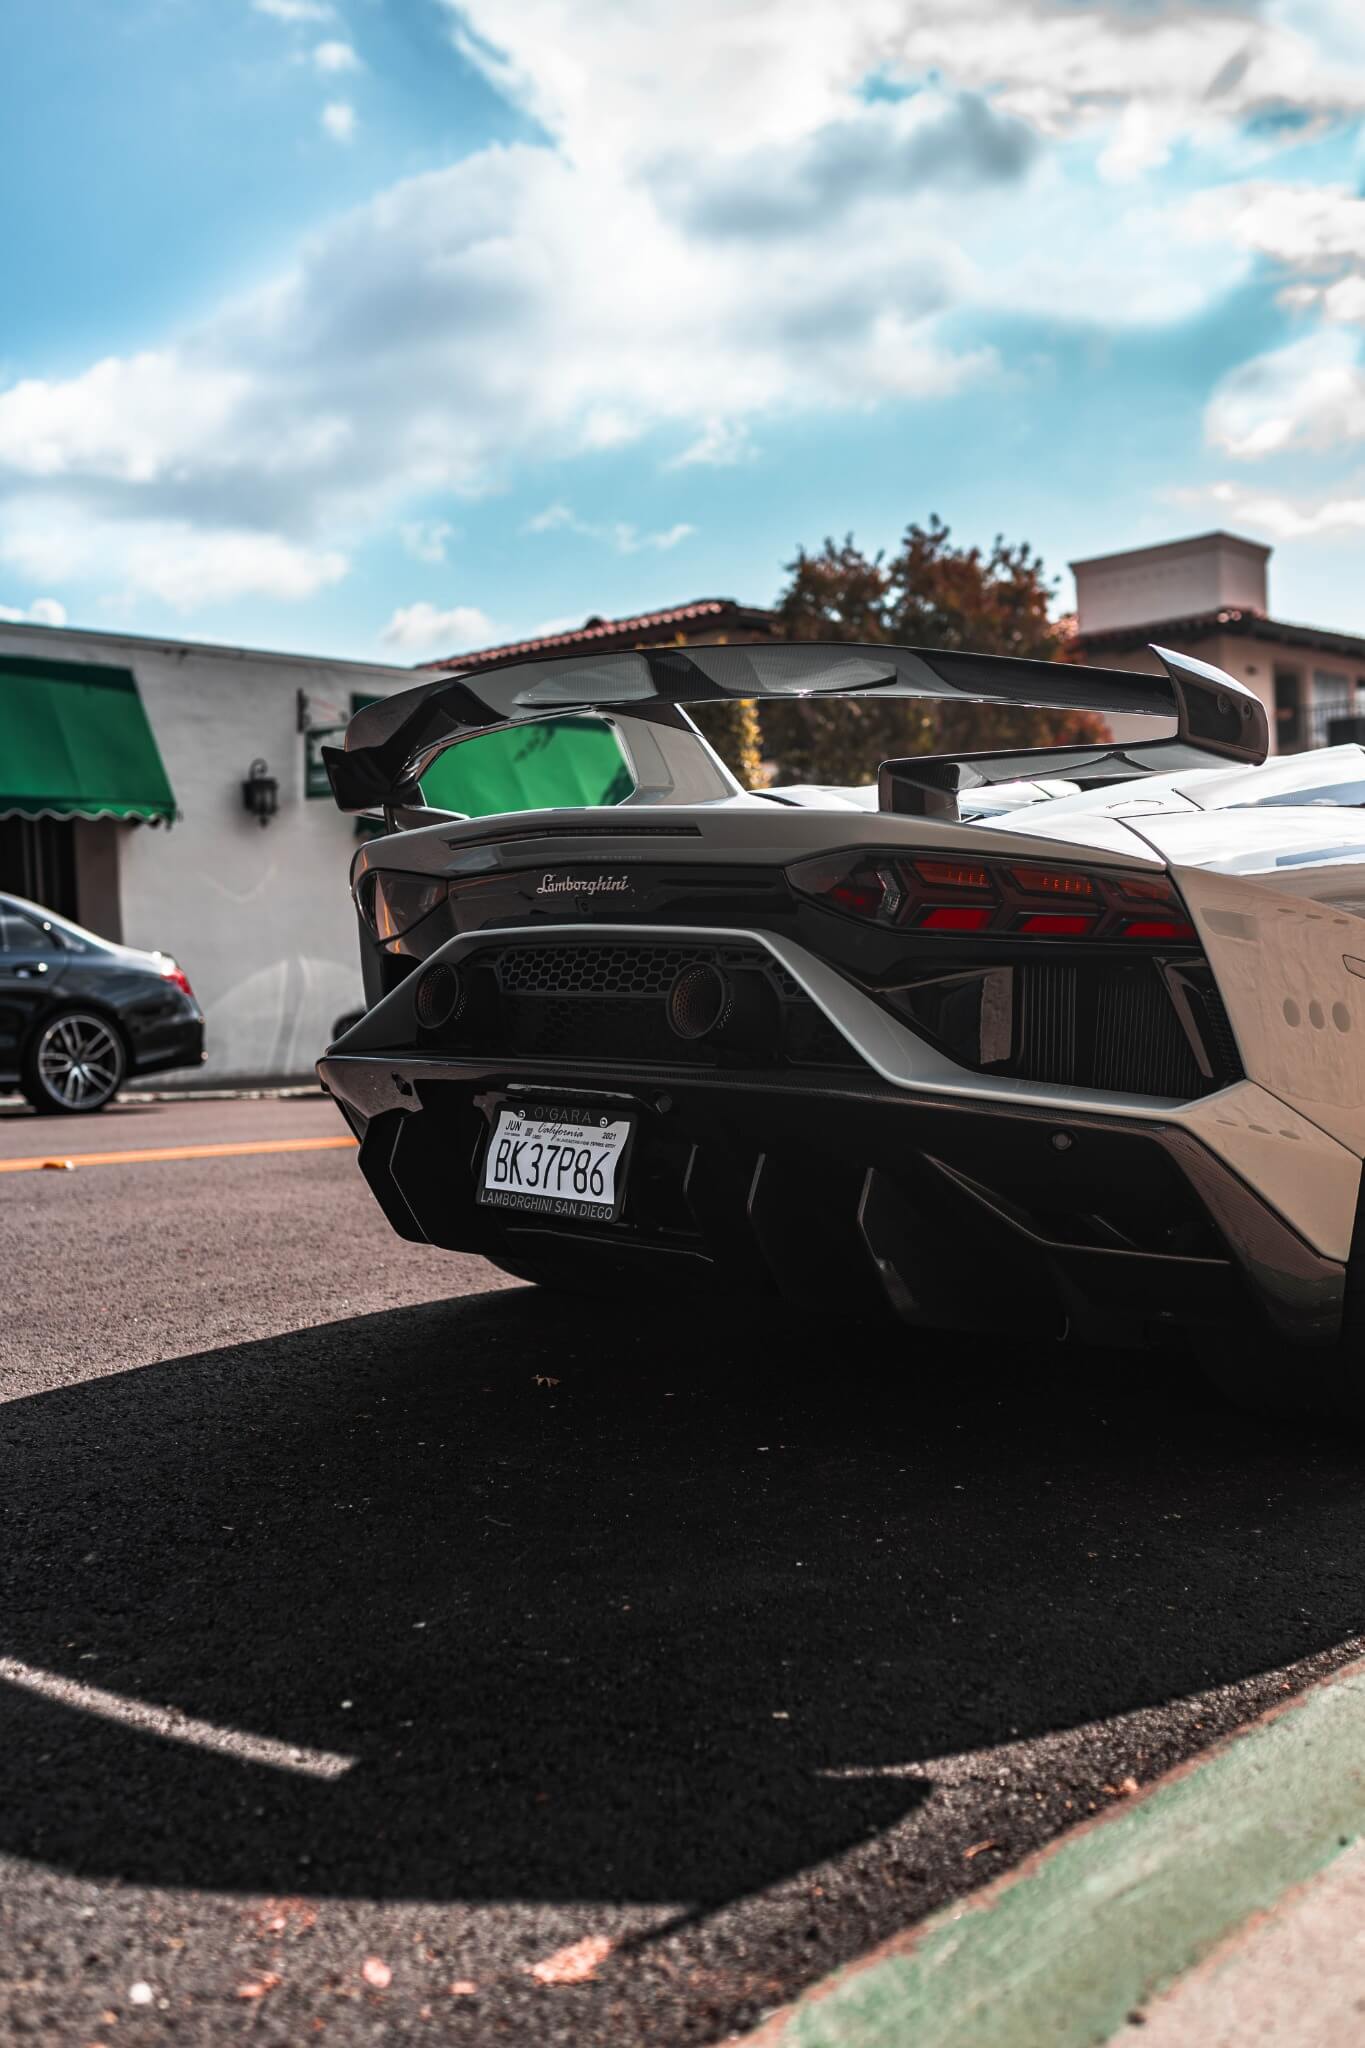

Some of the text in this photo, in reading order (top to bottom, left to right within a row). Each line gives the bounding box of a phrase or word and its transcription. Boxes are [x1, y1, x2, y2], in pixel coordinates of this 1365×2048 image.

[536, 874, 629, 895] Lamborghini
[534, 1106, 592, 1124] O'GARA
[505, 1120, 522, 1132] JUN
[537, 1122, 584, 1141] California
[602, 1132, 617, 1141] 2021
[494, 1139, 611, 1197] BK37P86
[480, 1191, 613, 1220] LAMBORGHINI SAN DIEGO
